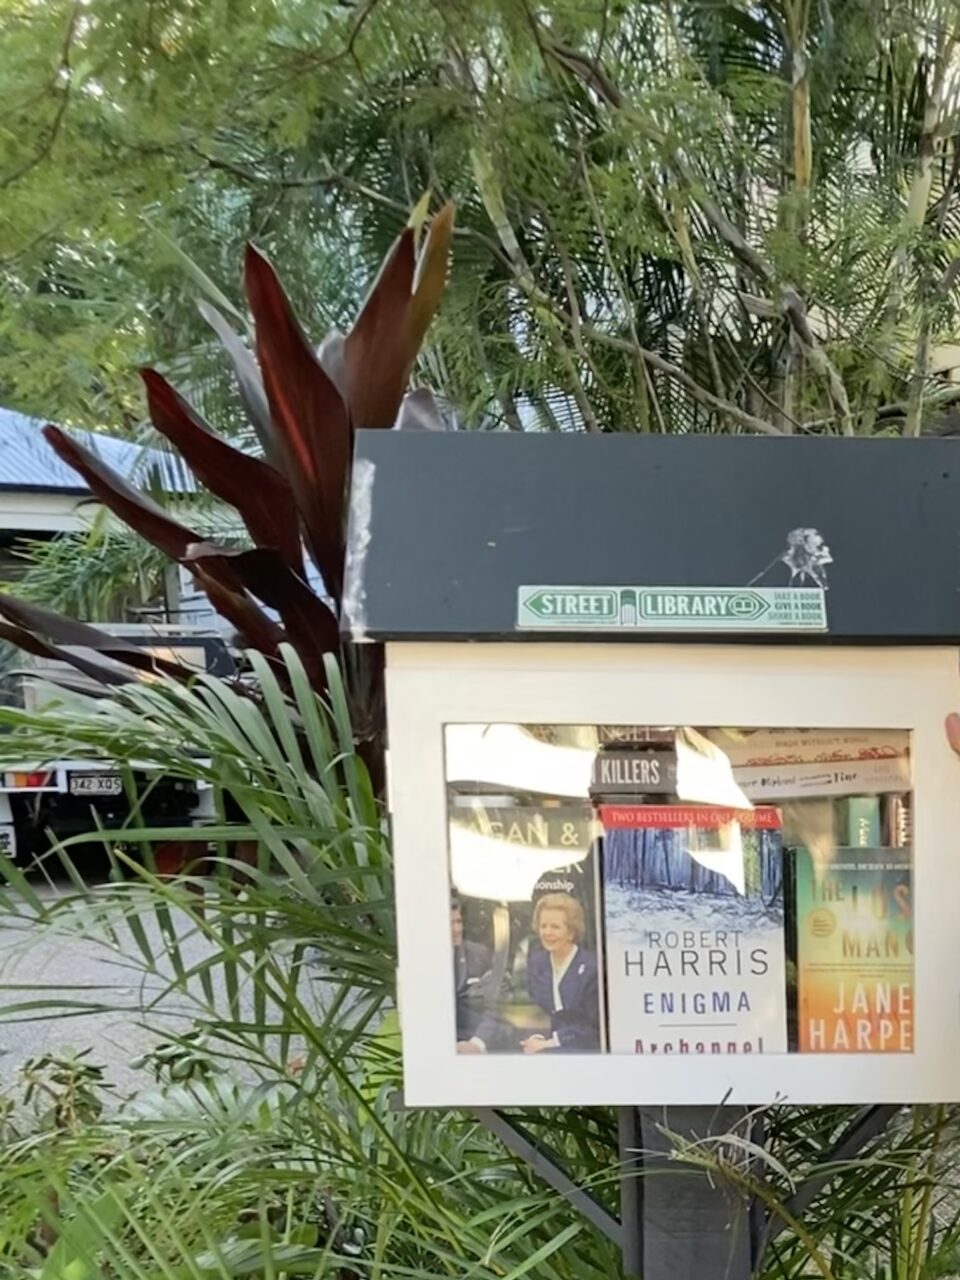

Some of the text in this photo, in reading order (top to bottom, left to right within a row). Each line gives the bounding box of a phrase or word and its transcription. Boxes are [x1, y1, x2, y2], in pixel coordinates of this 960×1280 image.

[541, 594, 730, 616] STREET LIBRARY
[774, 592, 791, 600] TAKE
[800, 592, 821, 600] BOOK
[774, 602, 792, 610] GIVE
[801, 602, 821, 610] BOOK
[767, 612, 793, 620] SHARE
[801, 612, 823, 620] BOOK
[601, 759, 660, 784] KILLERS
[72, 778, 121, 790] 342 XQS
[611, 811, 634, 823] TWO
[636, 811, 695, 823] BESTSELLERS
[697, 811, 708, 822] IN
[560, 822, 580, 846] &
[809, 879, 845, 902] THE
[648, 930, 744, 949] ROBERT
[624, 948, 769, 977] HARRIS
[643, 991, 751, 1014] ENIGMA
[833, 982, 911, 1015] JANE
